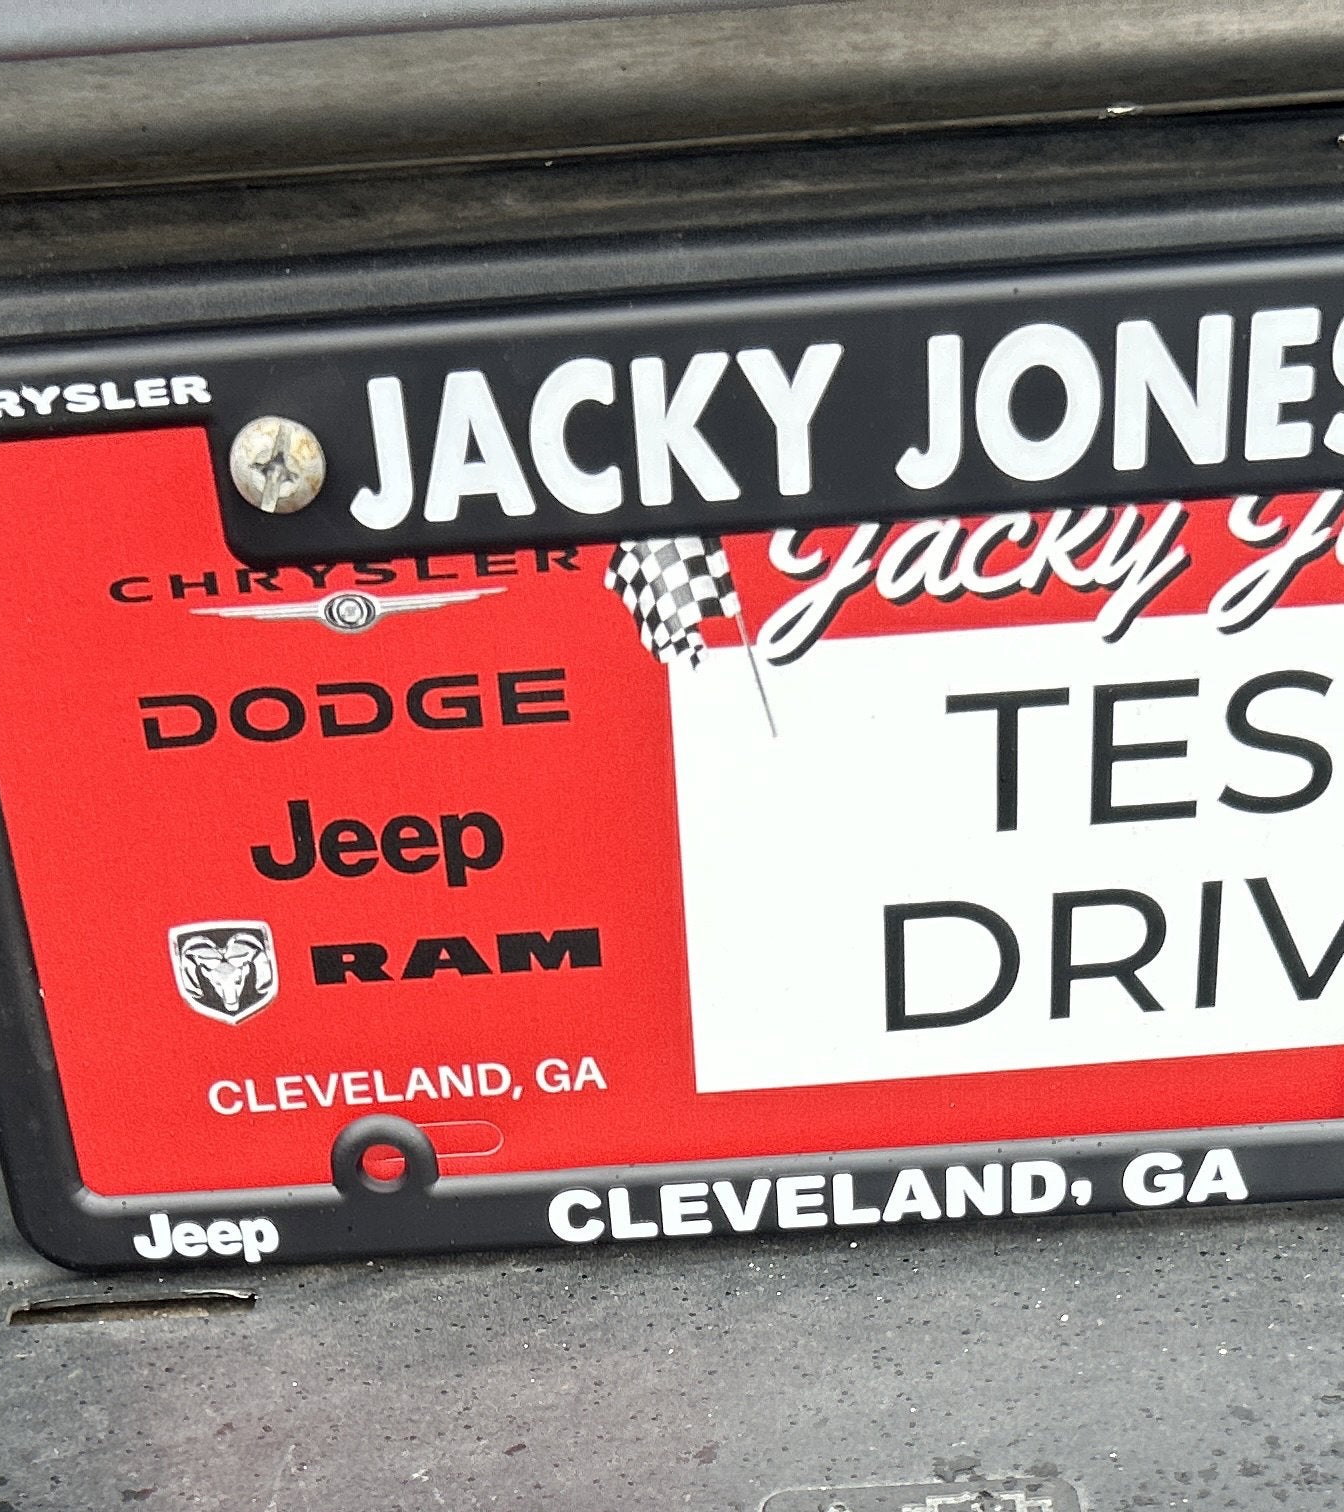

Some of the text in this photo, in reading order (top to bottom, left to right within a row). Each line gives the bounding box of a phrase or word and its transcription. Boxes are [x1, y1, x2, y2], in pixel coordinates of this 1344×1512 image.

[350, 342, 842, 530] JACKY
[109, 546, 582, 604] CHRYSLER
[758, 501, 1190, 665] Jacky
[139, 668, 570, 751] DODGE
[249, 798, 504, 887] Jeep
[311, 928, 602, 986] RAM
[208, 1056, 607, 1116] CLEVELAND, GA
[548, 1148, 1248, 1243] CLEVELAND, GA
[132, 1212, 280, 1263] Jeep
